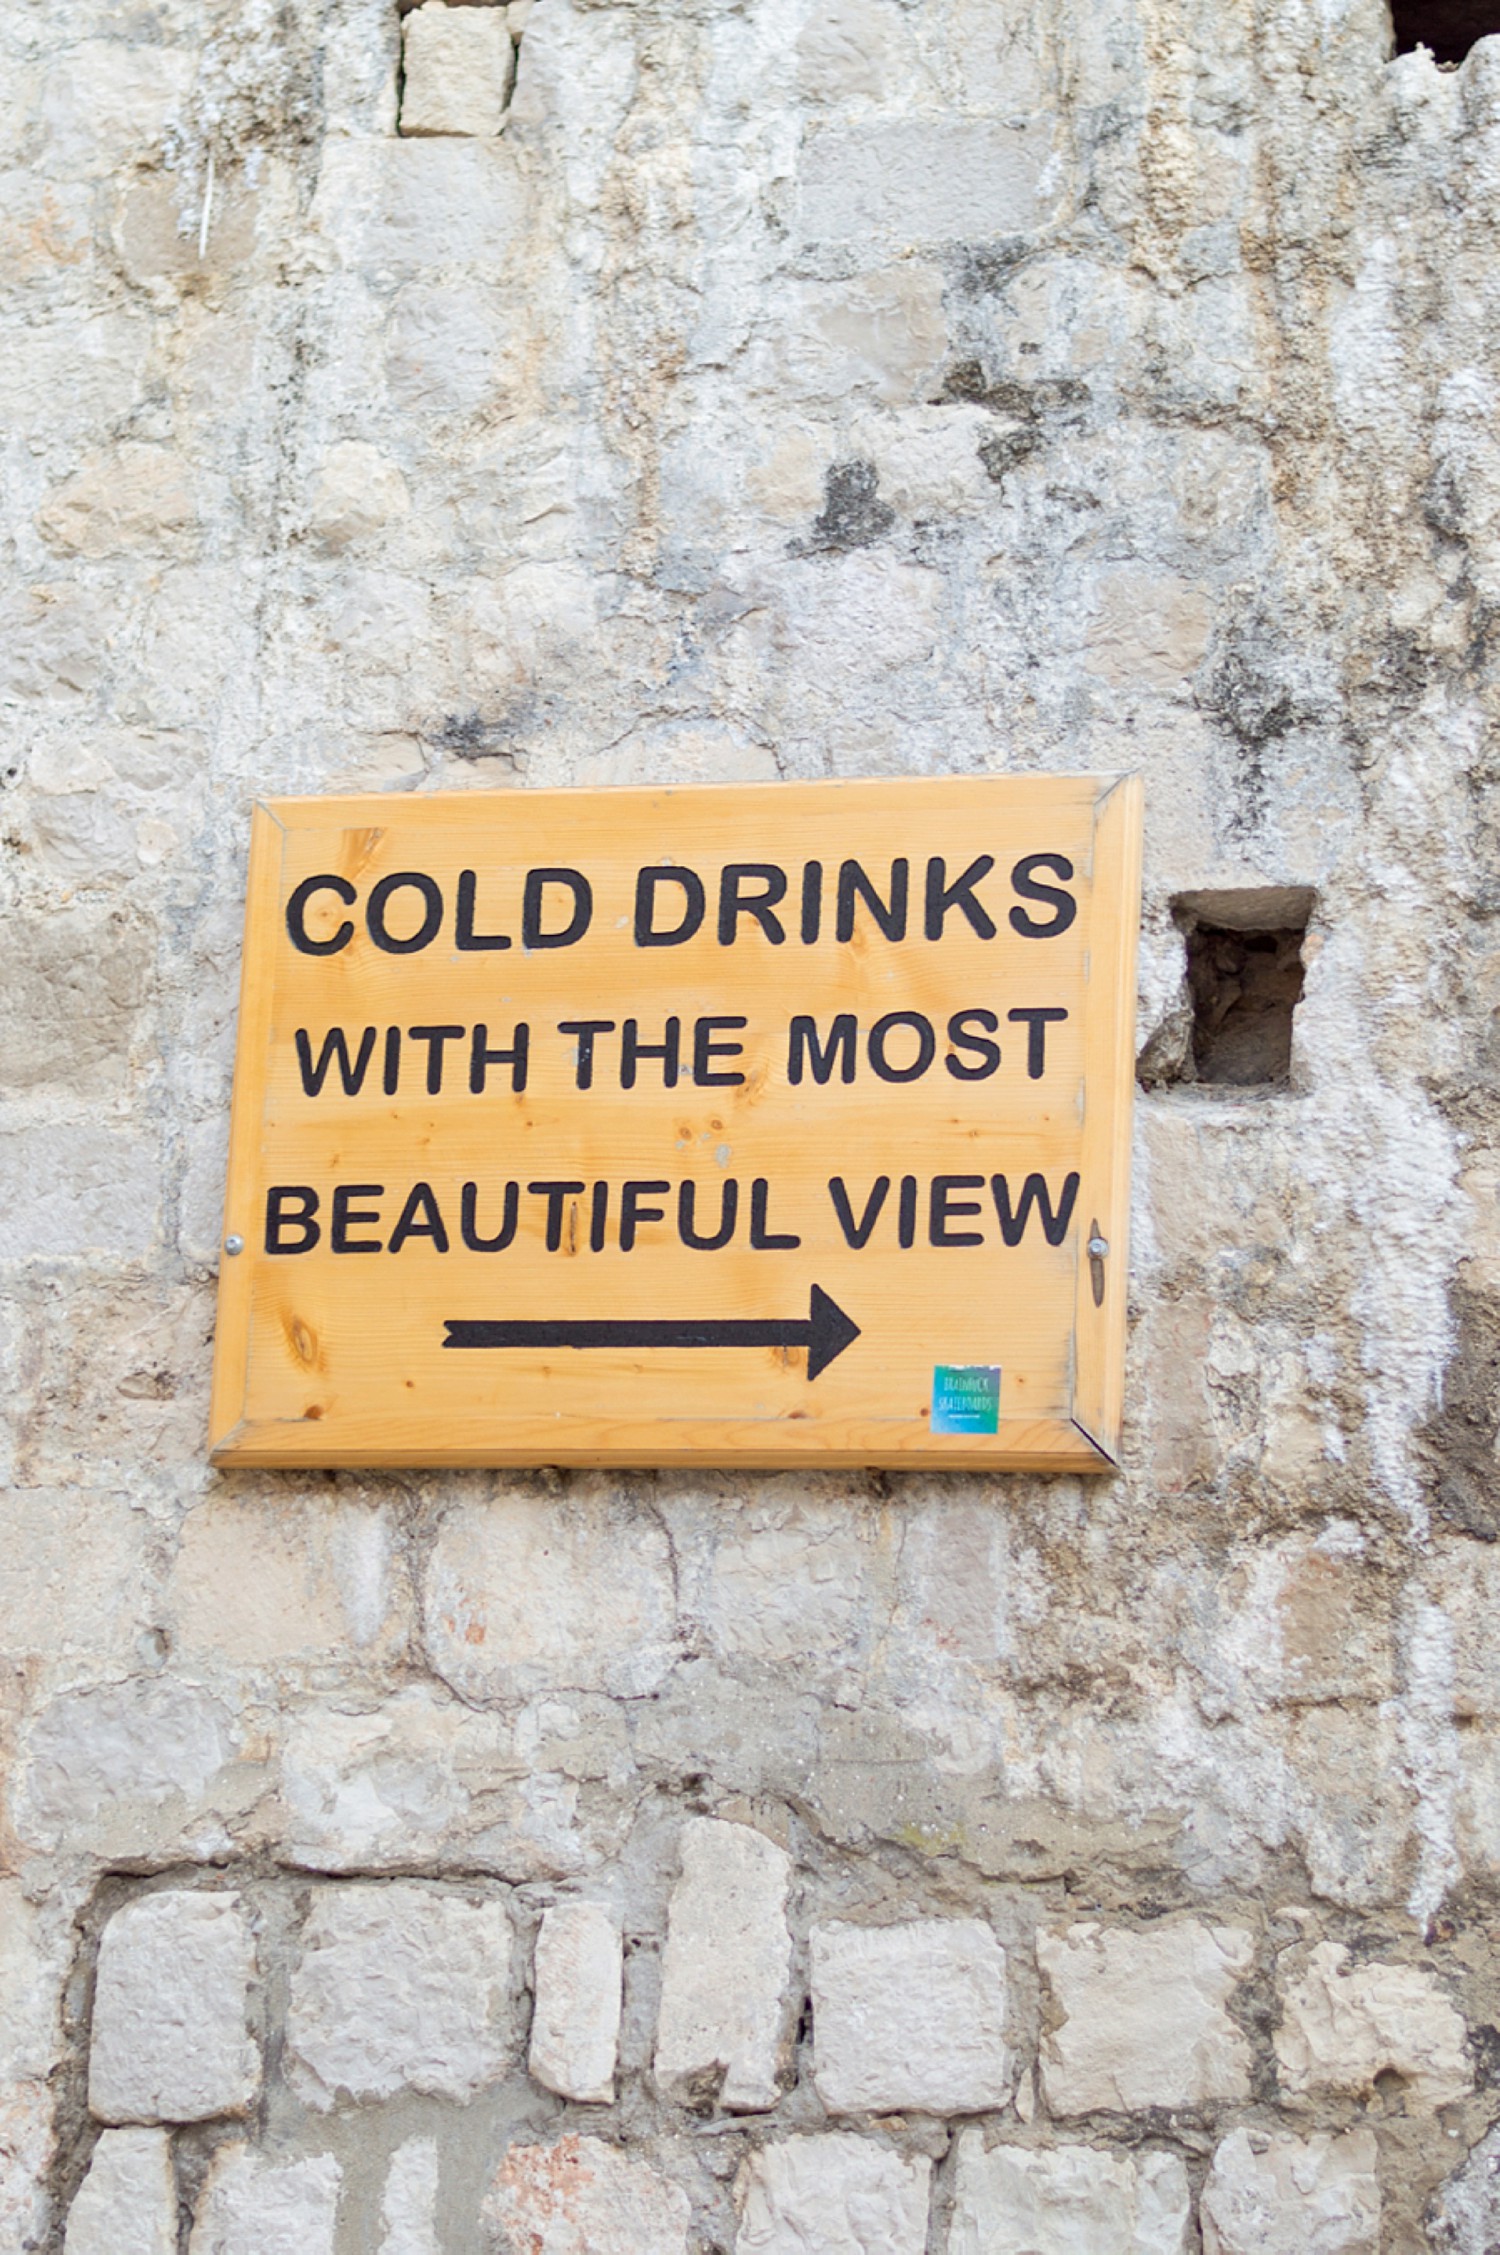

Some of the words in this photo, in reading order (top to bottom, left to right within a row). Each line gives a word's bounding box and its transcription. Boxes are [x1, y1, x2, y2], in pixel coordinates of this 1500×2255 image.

[285, 868, 594, 957] COLD
[633, 853, 1078, 949] DRINKS
[293, 1021, 531, 1098] WITH
[556, 1015, 748, 1091] THE
[786, 1006, 1069, 1087] MOST
[263, 1176, 802, 1256] BEAUTIFUL
[827, 1170, 1081, 1251] VIEW
